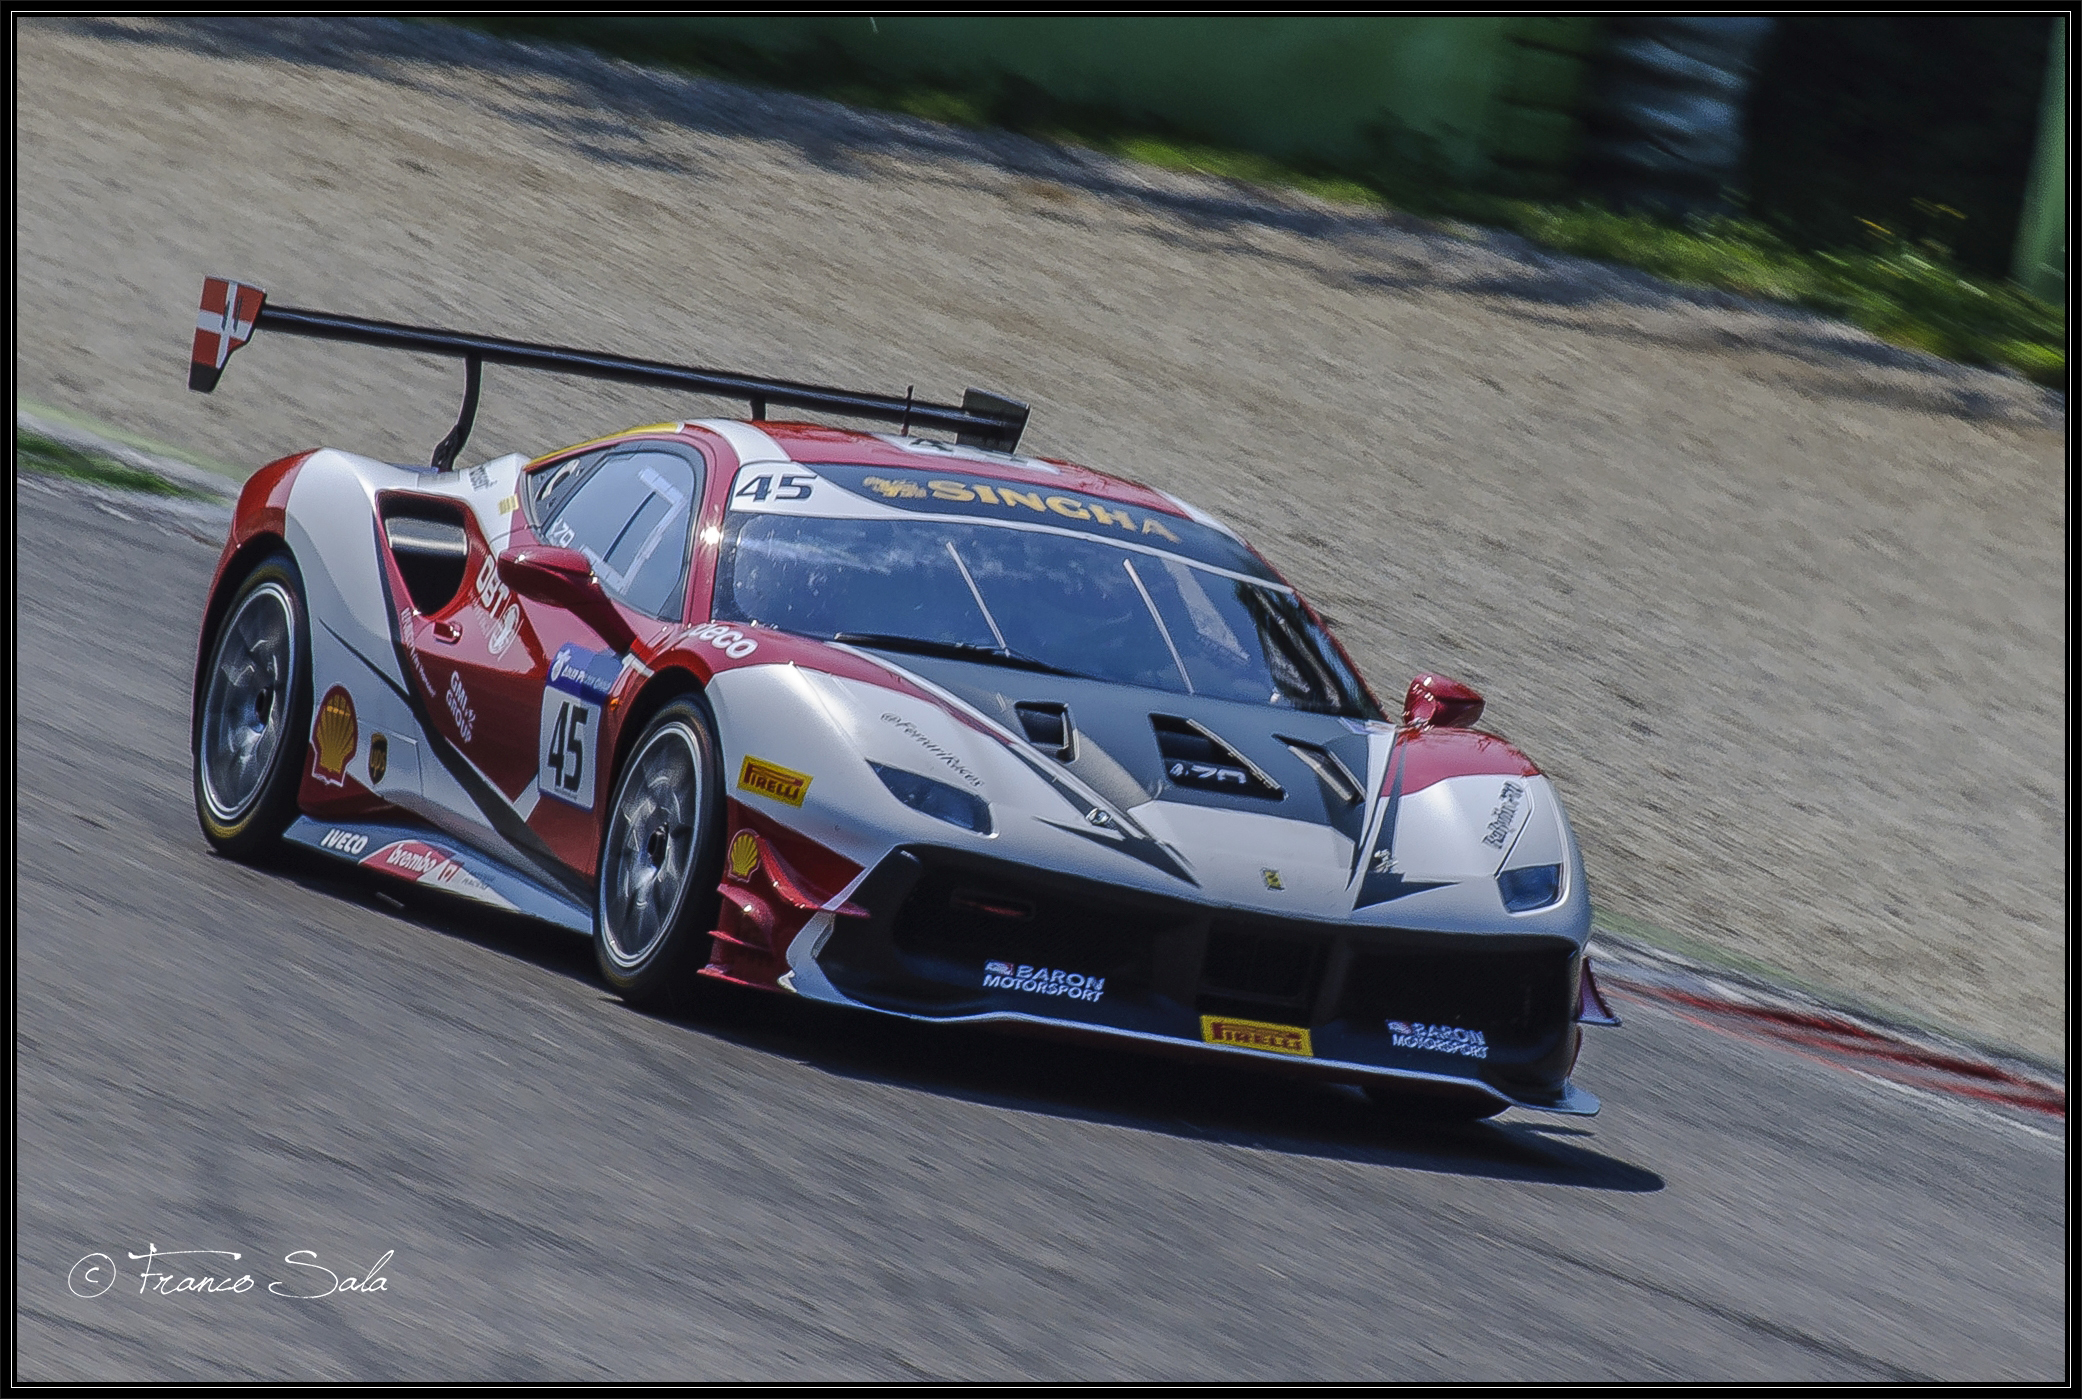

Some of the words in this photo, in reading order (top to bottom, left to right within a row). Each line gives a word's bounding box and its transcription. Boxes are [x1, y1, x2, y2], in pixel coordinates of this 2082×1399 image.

[735, 474, 818, 502] 45
[928, 480, 1181, 543] SINGHA
[446, 689, 473, 742] GROUP
[547, 701, 589, 792] 45
[743, 762, 804, 800] PIRELLI
[320, 828, 369, 855] IVECO
[386, 843, 437, 874] brembo
[982, 974, 1104, 1002] MOTORSPORT
[1016, 964, 1106, 990] BARON
[1211, 1021, 1303, 1053] PIRELLI
